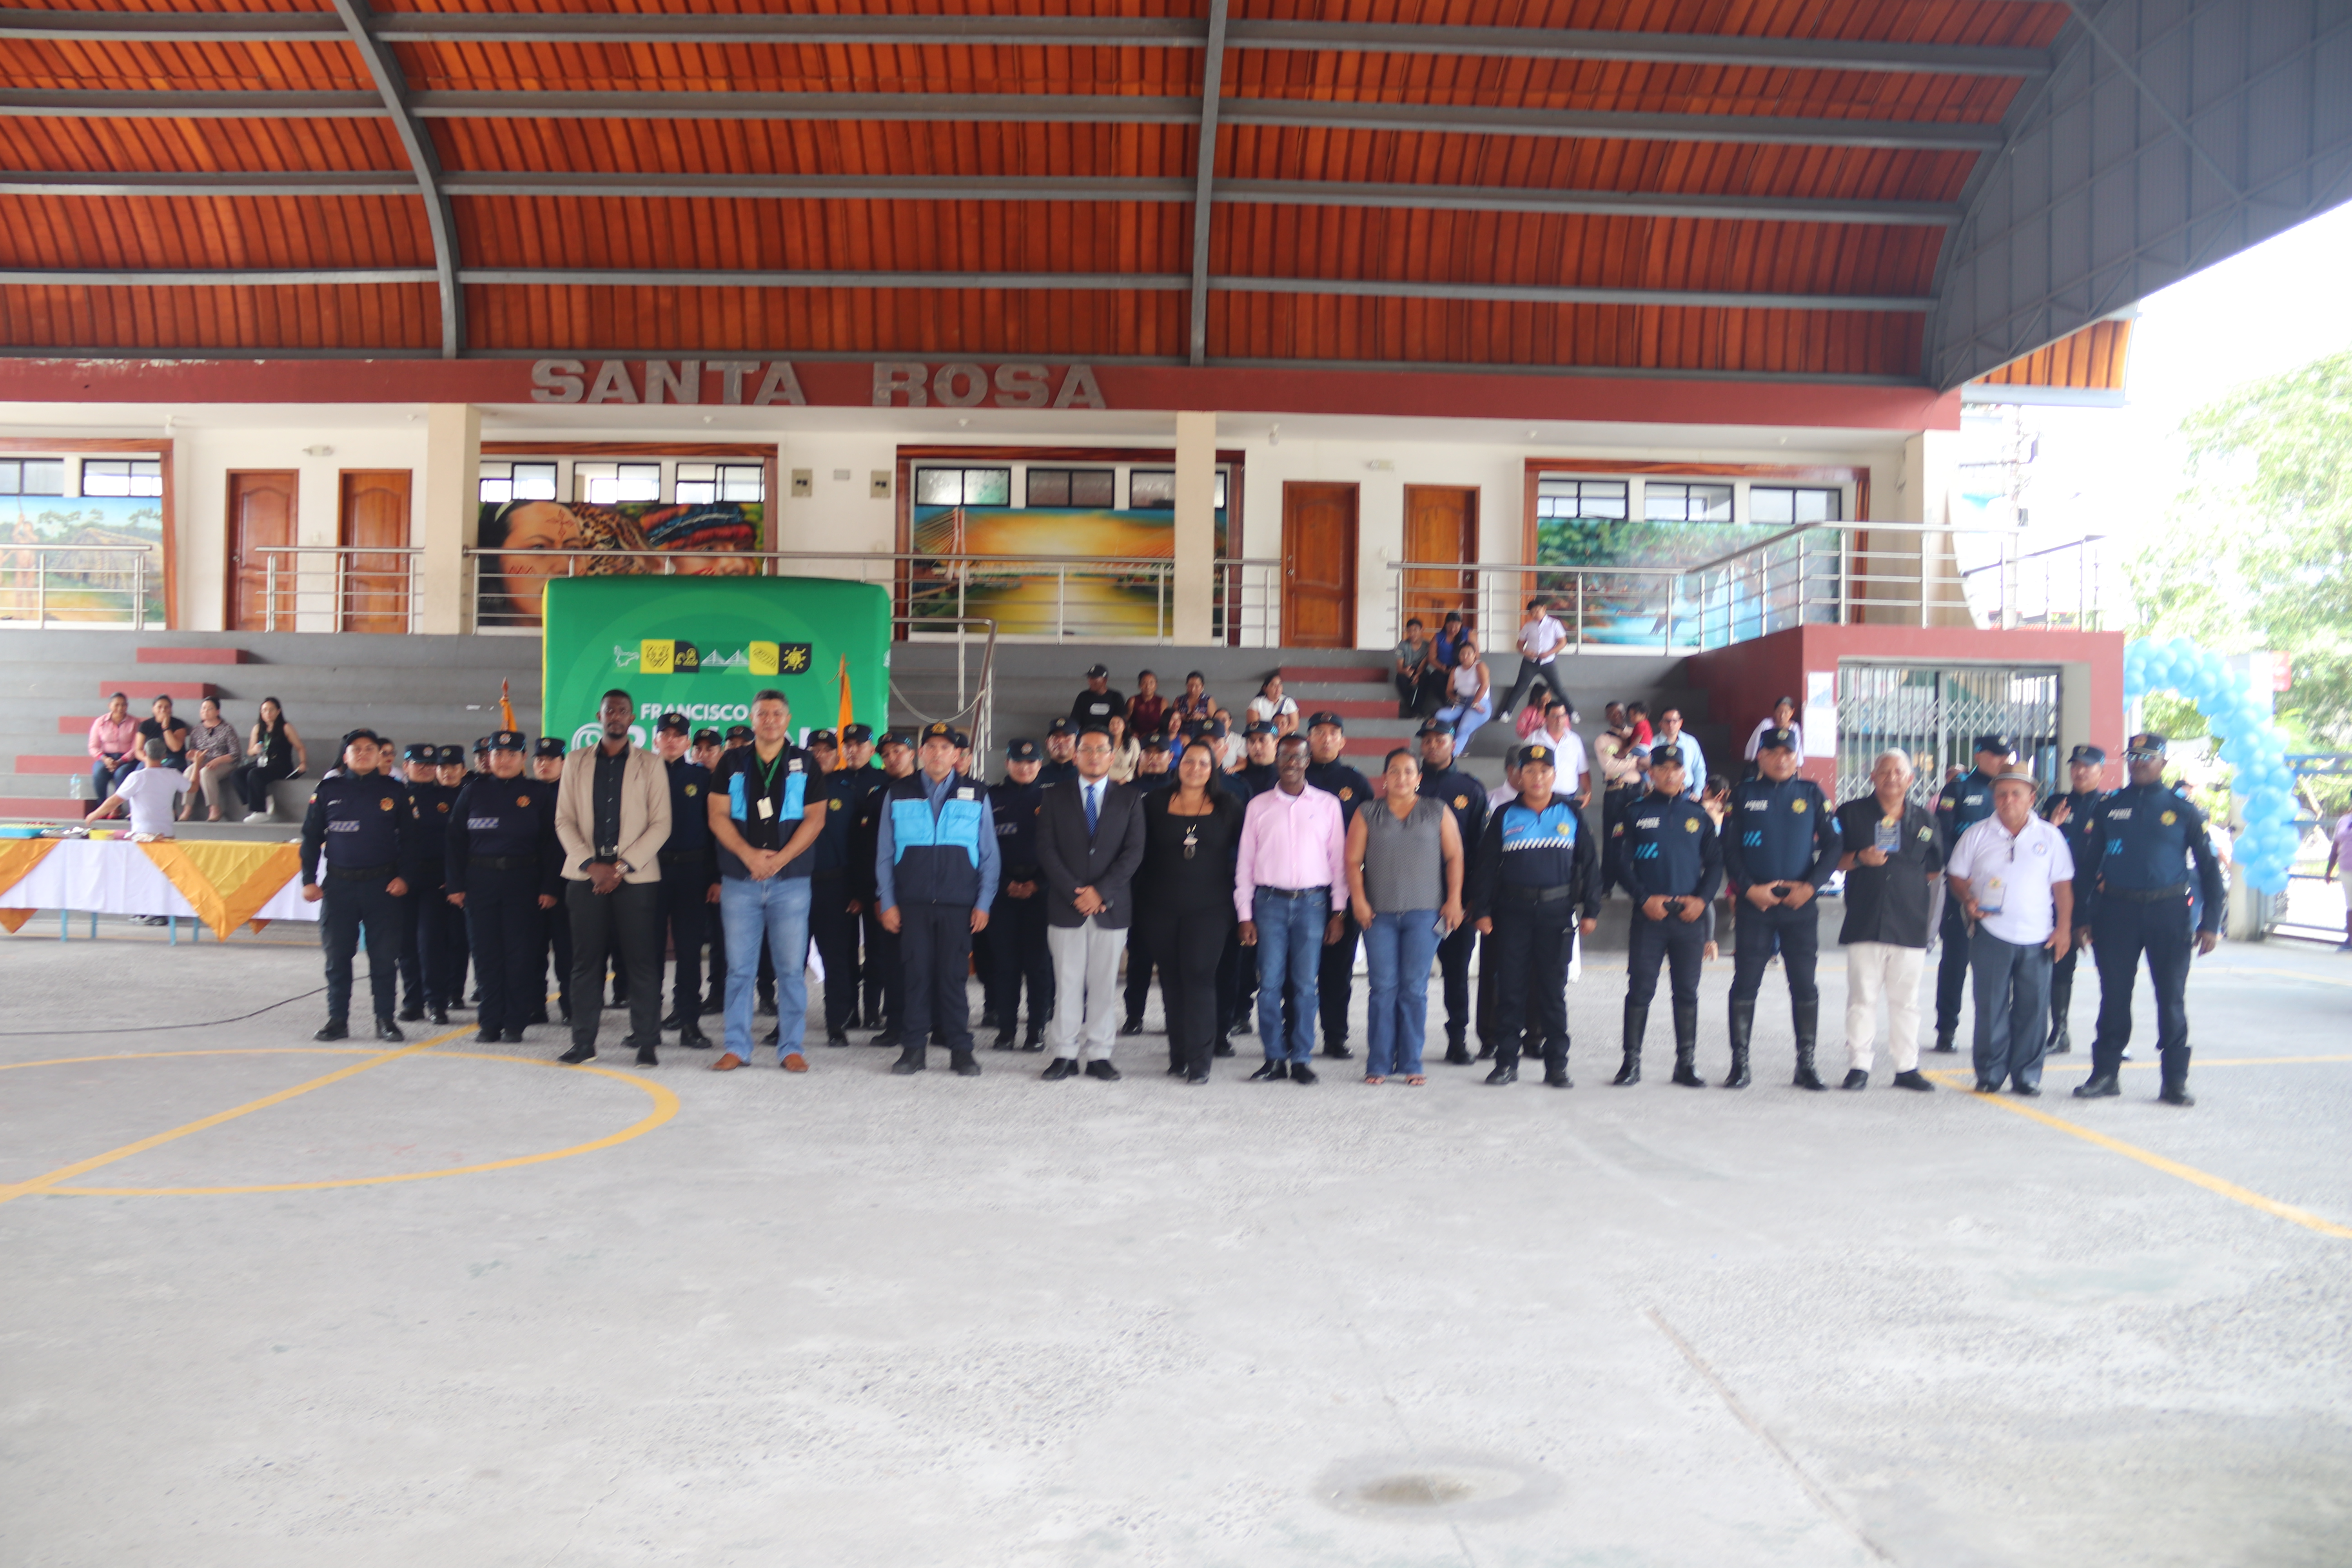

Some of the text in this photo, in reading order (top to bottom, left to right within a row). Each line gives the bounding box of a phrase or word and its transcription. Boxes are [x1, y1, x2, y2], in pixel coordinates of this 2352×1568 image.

[531, 359, 1107, 408] SANTA ROSA
[640, 703, 749, 722] FRANCISCO
